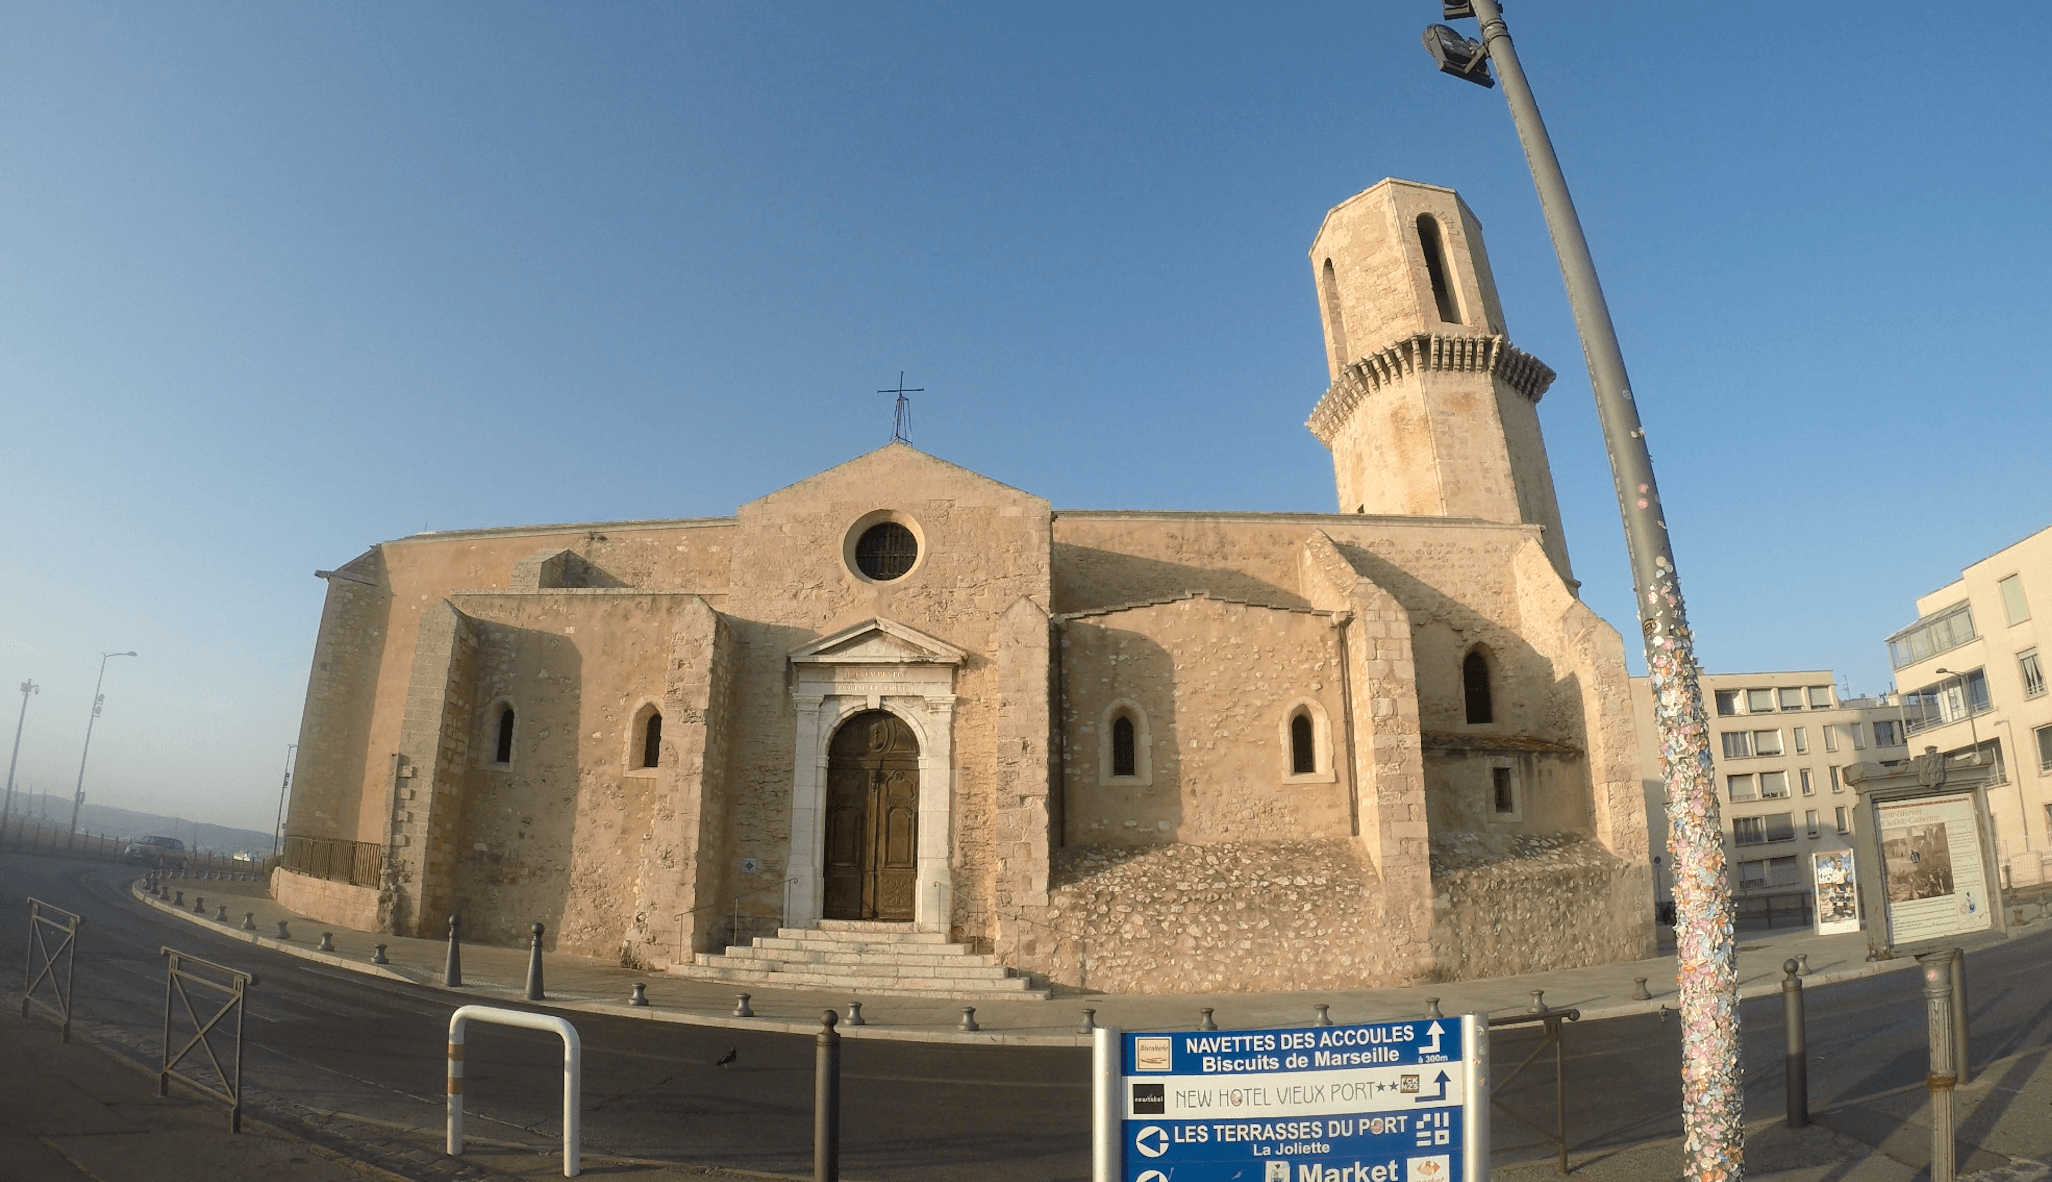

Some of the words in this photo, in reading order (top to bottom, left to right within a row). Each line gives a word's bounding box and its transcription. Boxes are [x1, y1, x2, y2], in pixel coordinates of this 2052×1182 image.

[1186, 1034, 1276, 1054] NAVETTES
[1280, 1032, 1316, 1051] DES
[1319, 1025, 1415, 1048] ACCOULES
[1202, 1054, 1280, 1073] Biscuits
[1285, 1052, 1309, 1069] de
[1314, 1046, 1400, 1067] Marseille
[1418, 1056, 1424, 1064] à
[1425, 1054, 1448, 1063] 300m
[1175, 1089, 1213, 1109] NEW
[1219, 1087, 1272, 1108] HOTEL
[1276, 1084, 1325, 1106] VIEUX
[1330, 1081, 1376, 1102] PORT
[1174, 1125, 1209, 1143] LES
[1212, 1120, 1323, 1142] TERRASSES
[1327, 1119, 1353, 1138] DU
[1358, 1115, 1408, 1136] PORT
[1253, 1143, 1271, 1157] La
[1275, 1141, 1331, 1156] Joliette
[1298, 1159, 1399, 1182] Market
